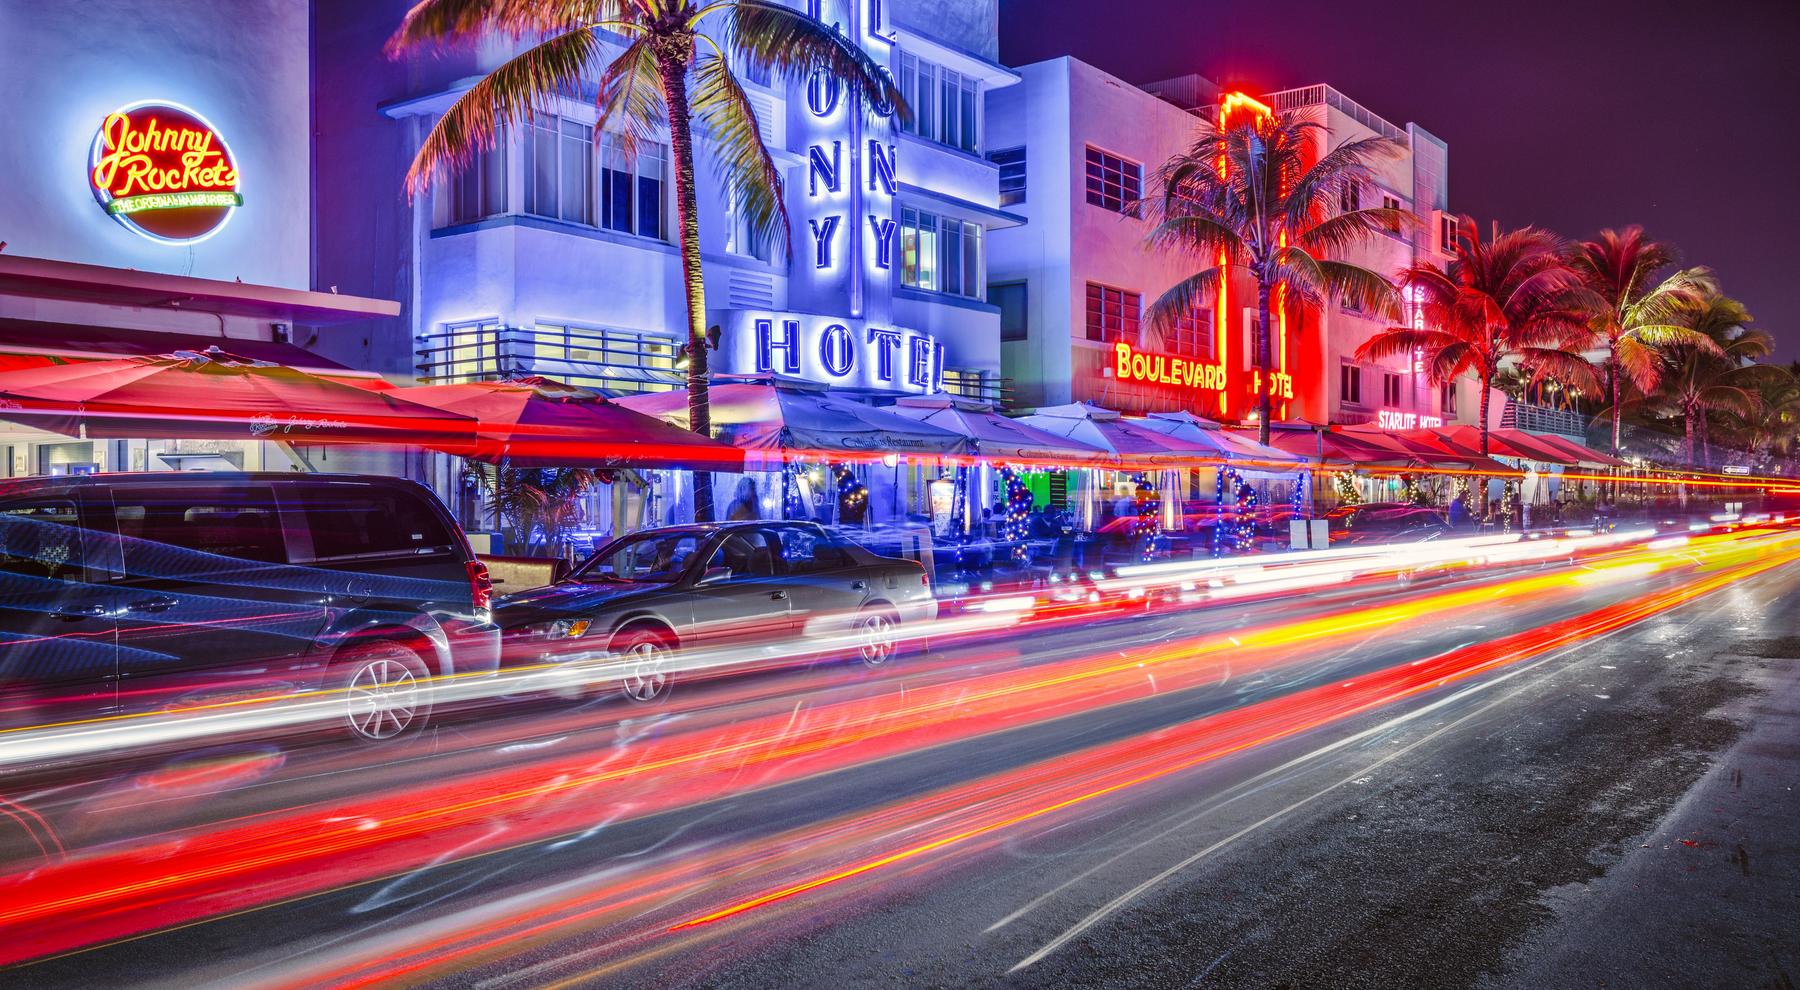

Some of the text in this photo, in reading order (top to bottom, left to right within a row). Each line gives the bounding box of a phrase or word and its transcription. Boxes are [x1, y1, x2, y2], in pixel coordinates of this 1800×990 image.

[94, 112, 222, 190] Johnny
[115, 154, 239, 196] Rockets
[113, 192, 236, 213] THE ORIGINAL HAMBURGER
[1413, 285, 1425, 373] STARTE
[755, 318, 945, 394] HOTEL
[1115, 342, 1227, 391] BOULEVARD
[1378, 410, 1417, 430] STARLITE
